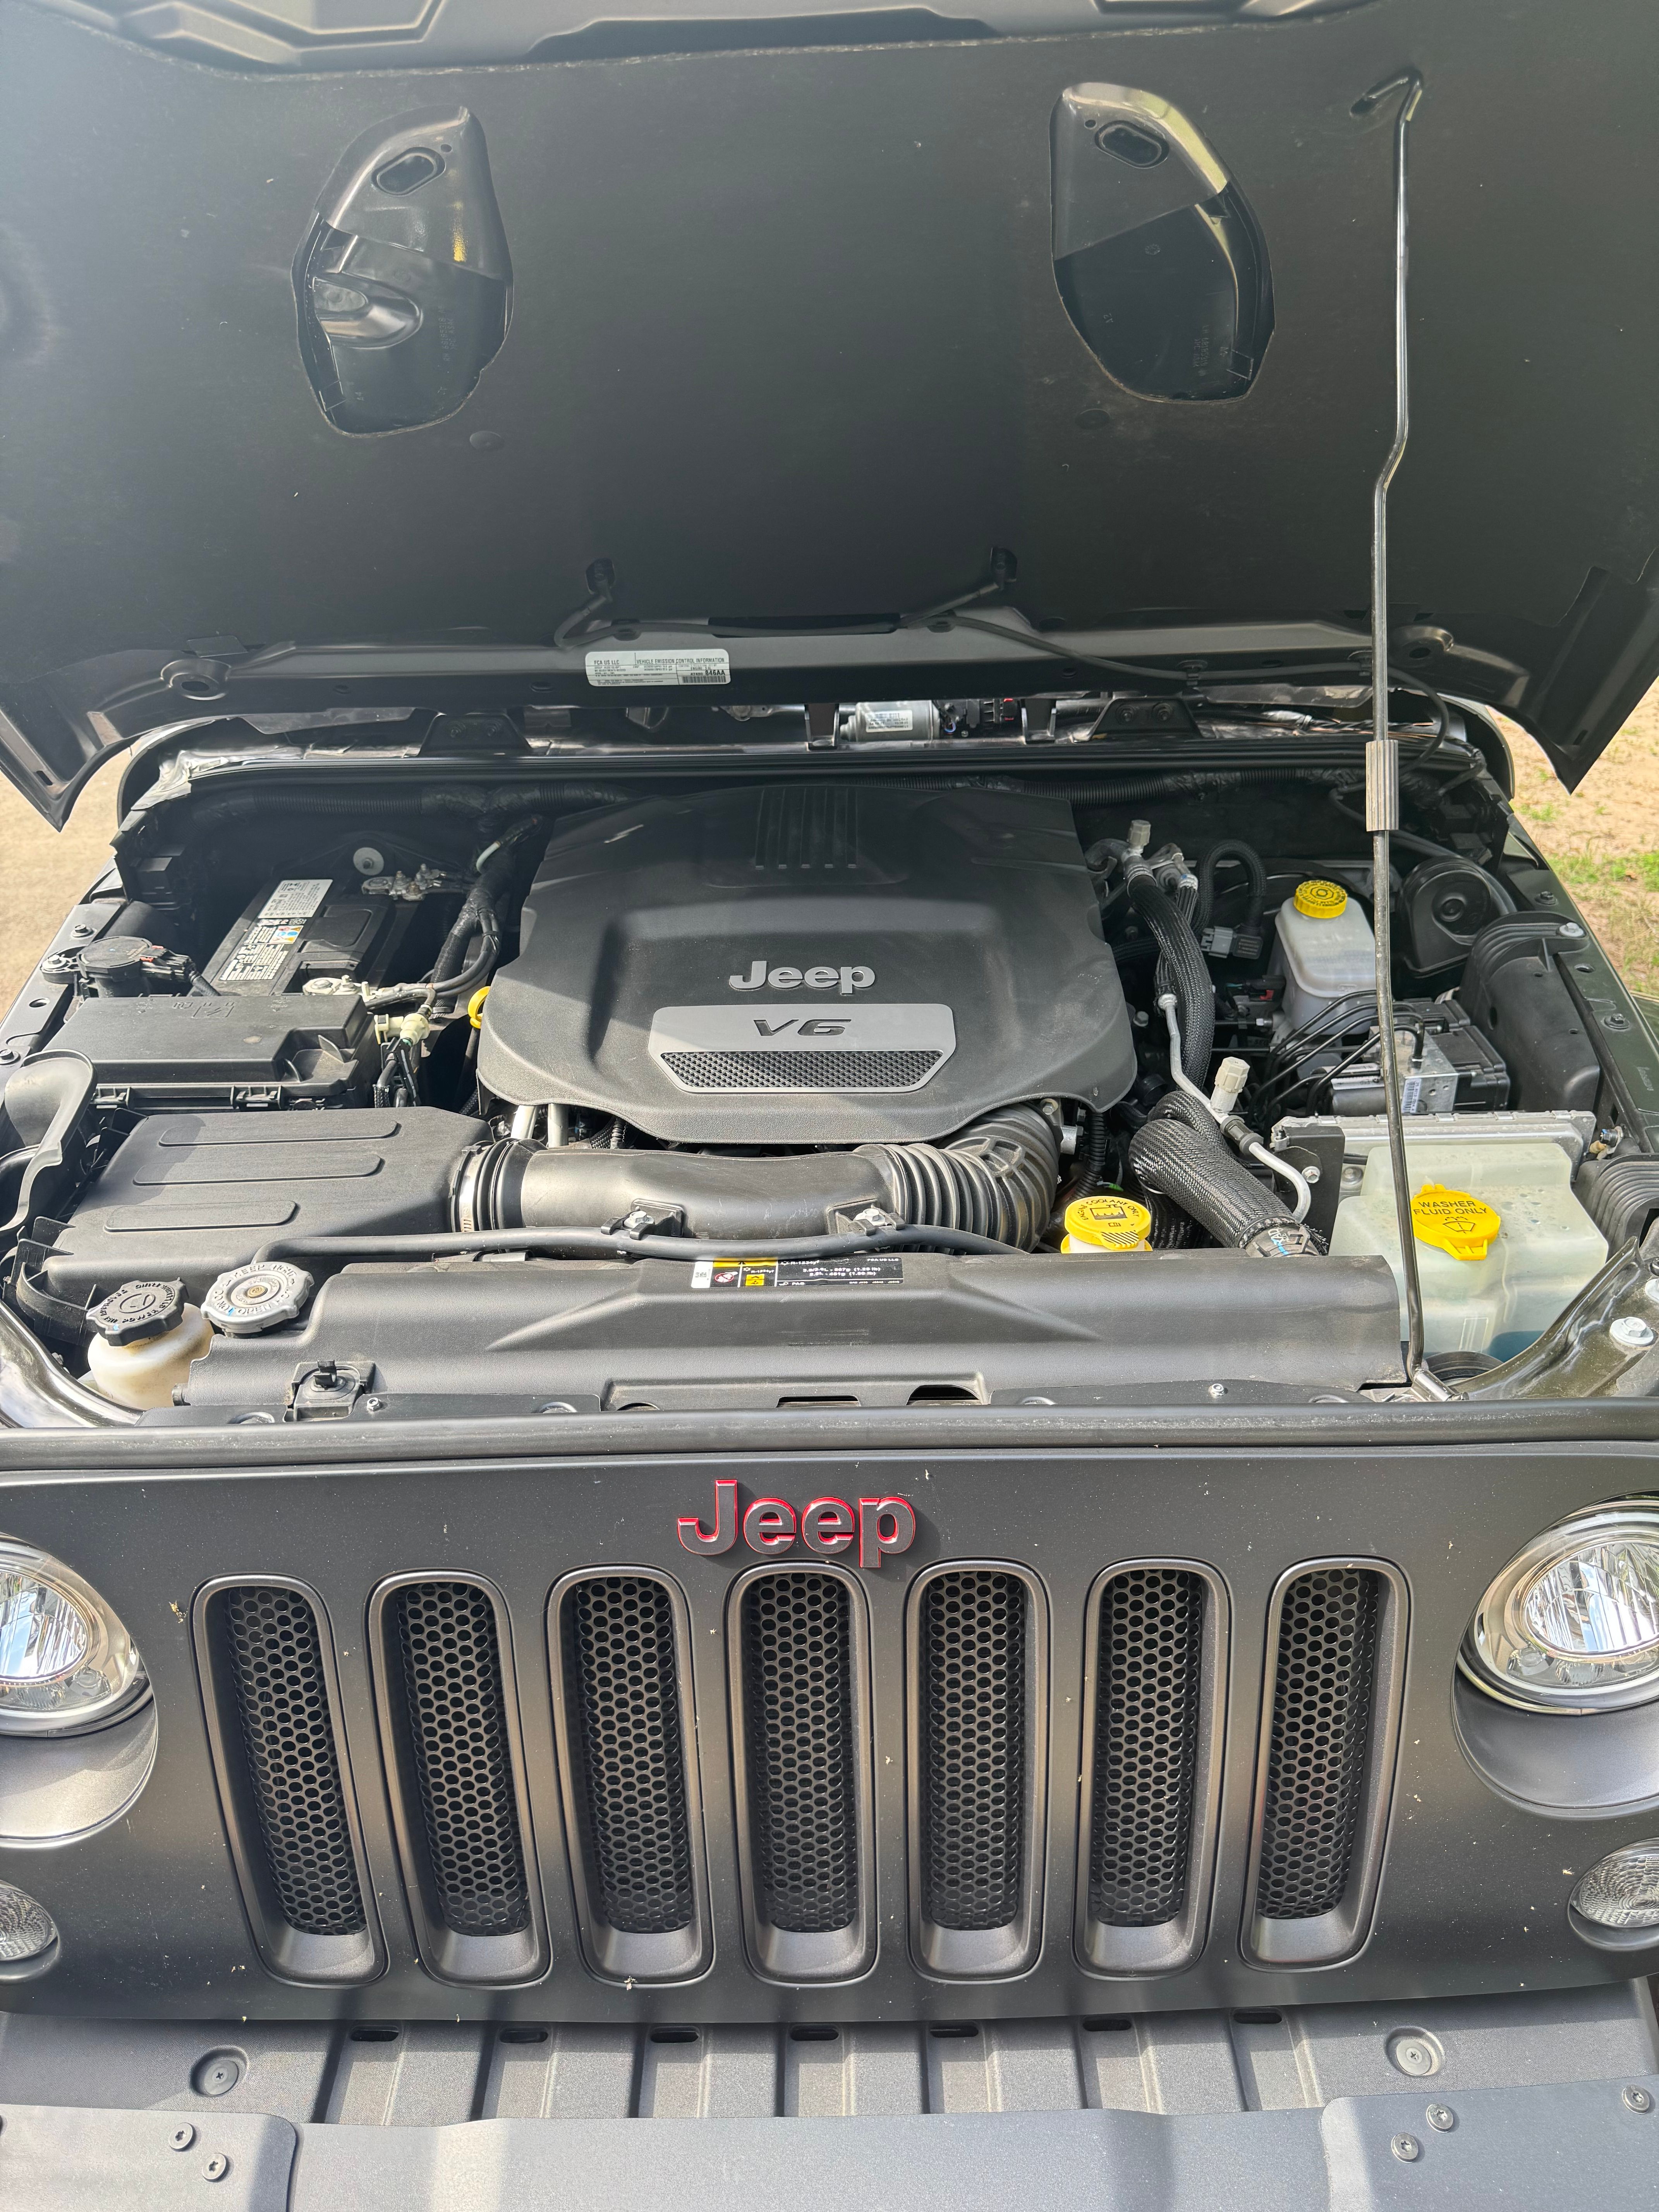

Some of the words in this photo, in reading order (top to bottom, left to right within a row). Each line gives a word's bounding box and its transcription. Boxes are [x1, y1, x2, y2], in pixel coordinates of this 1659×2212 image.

[730, 960, 876, 996] Jeep
[753, 1019, 852, 1037] V6
[1077, 1205, 1089, 1220] ENGINE
[1127, 1206, 1140, 1218] ONLY
[230, 1264, 265, 1278] KEEP
[271, 1264, 297, 1277] TIGHT
[122, 1309, 159, 1323] POWER
[236, 1304, 271, 1315] OPEN
[677, 1479, 916, 1568] Jeep
